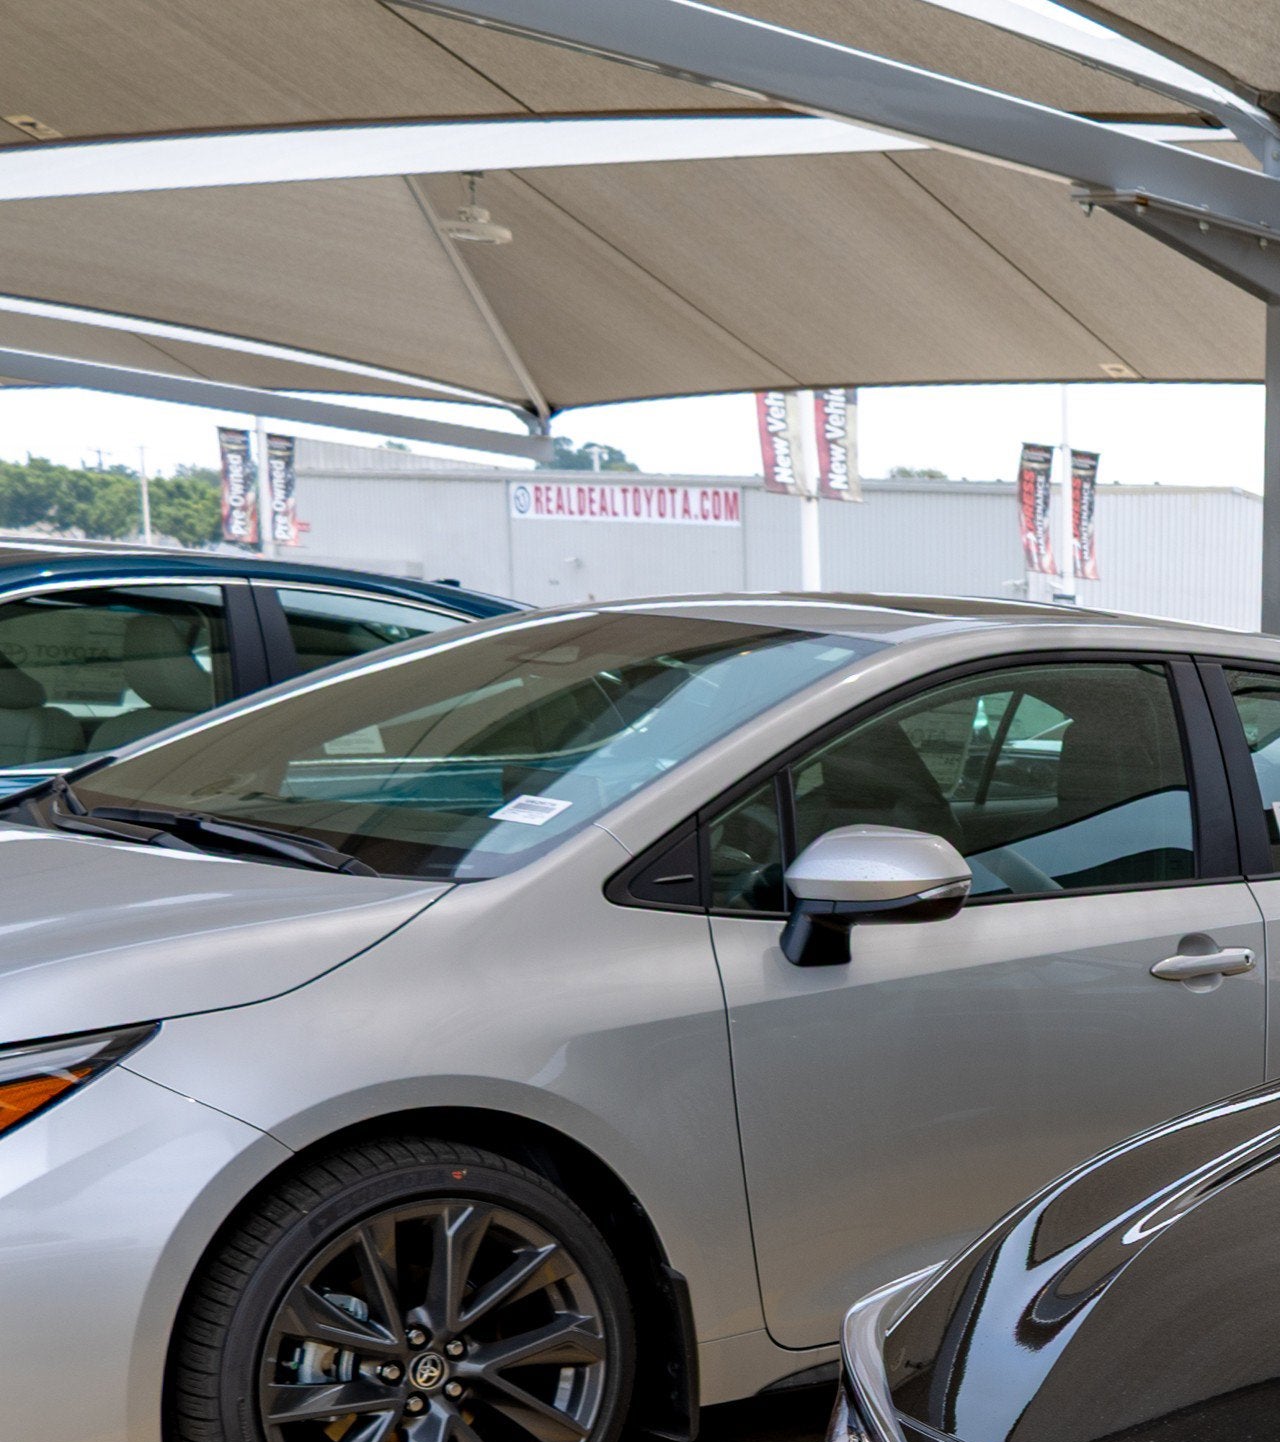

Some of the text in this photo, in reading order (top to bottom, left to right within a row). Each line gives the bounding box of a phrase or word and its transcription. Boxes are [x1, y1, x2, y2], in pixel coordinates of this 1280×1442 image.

[772, 437, 795, 484] New
[828, 444, 849, 490] New
[533, 485, 740, 521] REALDEALTOYOTA.COM
[34, 644, 111, 659] TOYOTA
